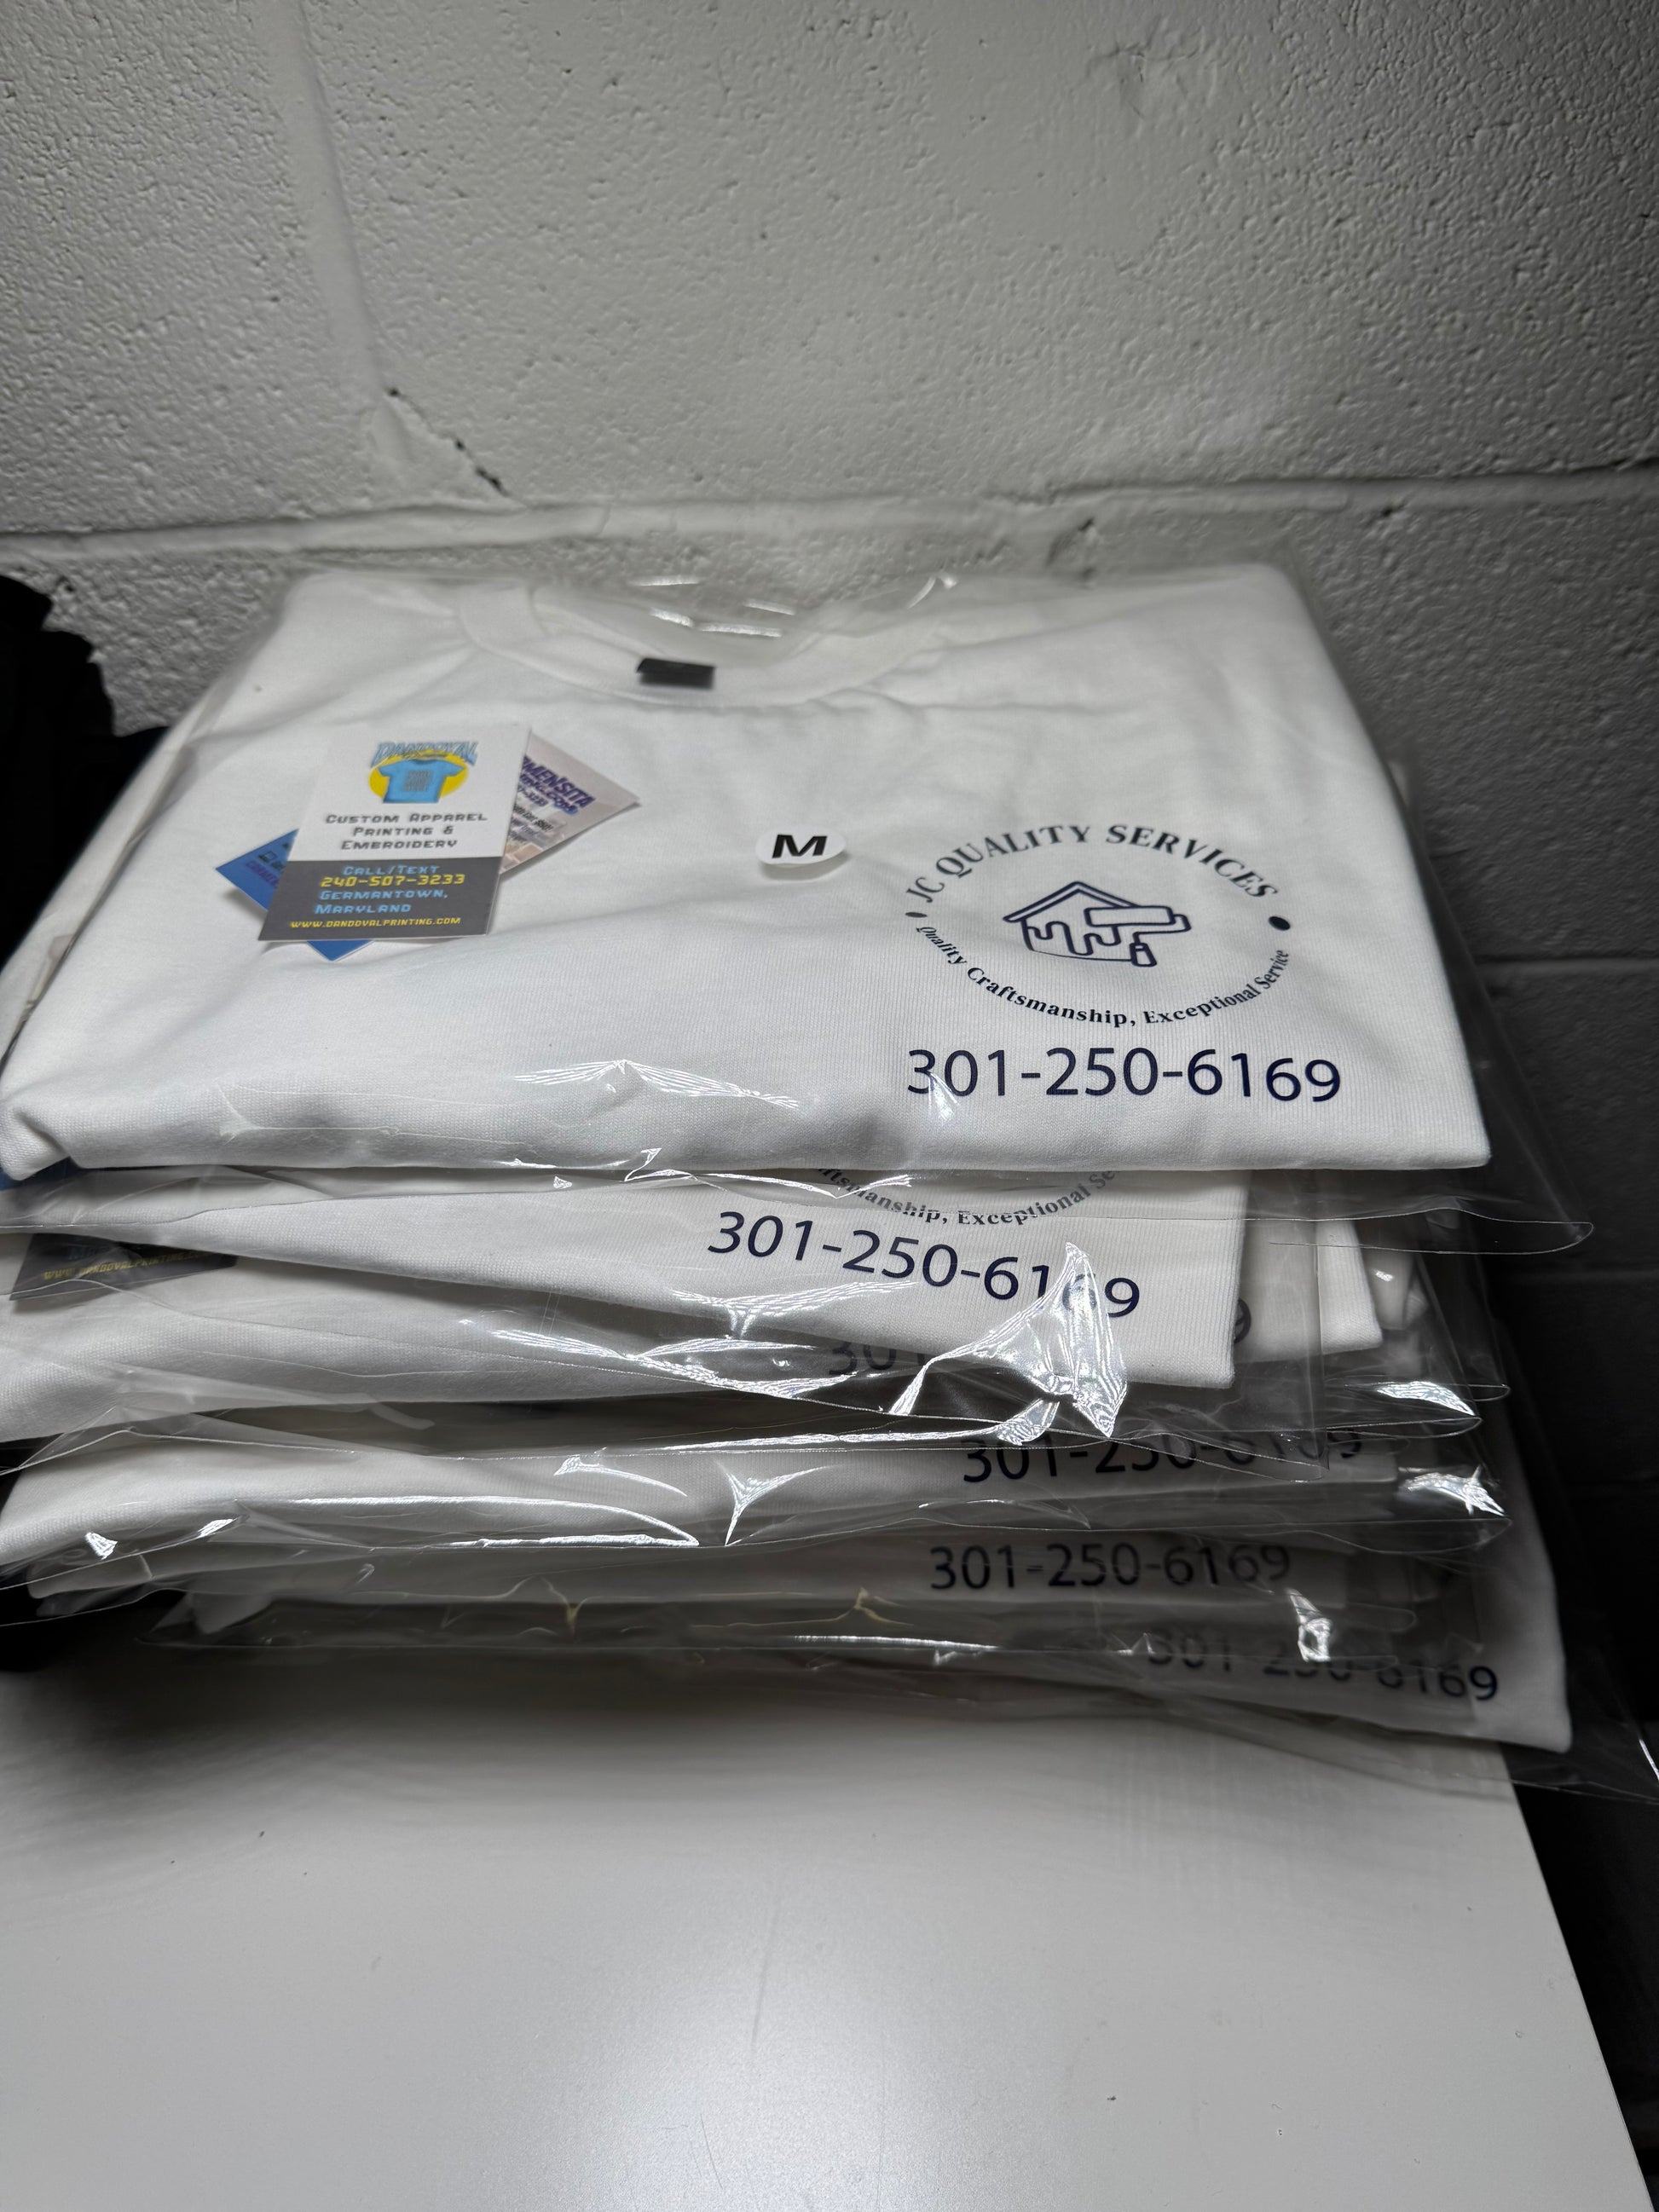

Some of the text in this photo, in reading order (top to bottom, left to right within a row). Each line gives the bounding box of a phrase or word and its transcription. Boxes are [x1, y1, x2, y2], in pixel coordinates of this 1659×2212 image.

[325, 812, 488, 824] CUSTOM APPAREL
[352, 825, 454, 837] PRINTING &
[341, 840, 458, 851] EMBROIDERY
[772, 834, 828, 858] M
[343, 864, 440, 876] CALL/TEXT
[905, 824, 1279, 904] JC QUALITY SERVICES
[320, 874, 465, 887] 240-507-3233
[320, 889, 449, 900] GERMANTOWN,
[314, 904, 412, 915] MARYLAND
[290, 917, 461, 928] WWW.DANDOVALPRINTING.COM
[916, 926, 1290, 1028] Quality Craftsmanship, Exceptional Service
[907, 1047, 1341, 1102] 301-250-6169
[957, 1182, 1092, 1226] Exceptional
[930, 1542, 1291, 1590] 301-250-6169
